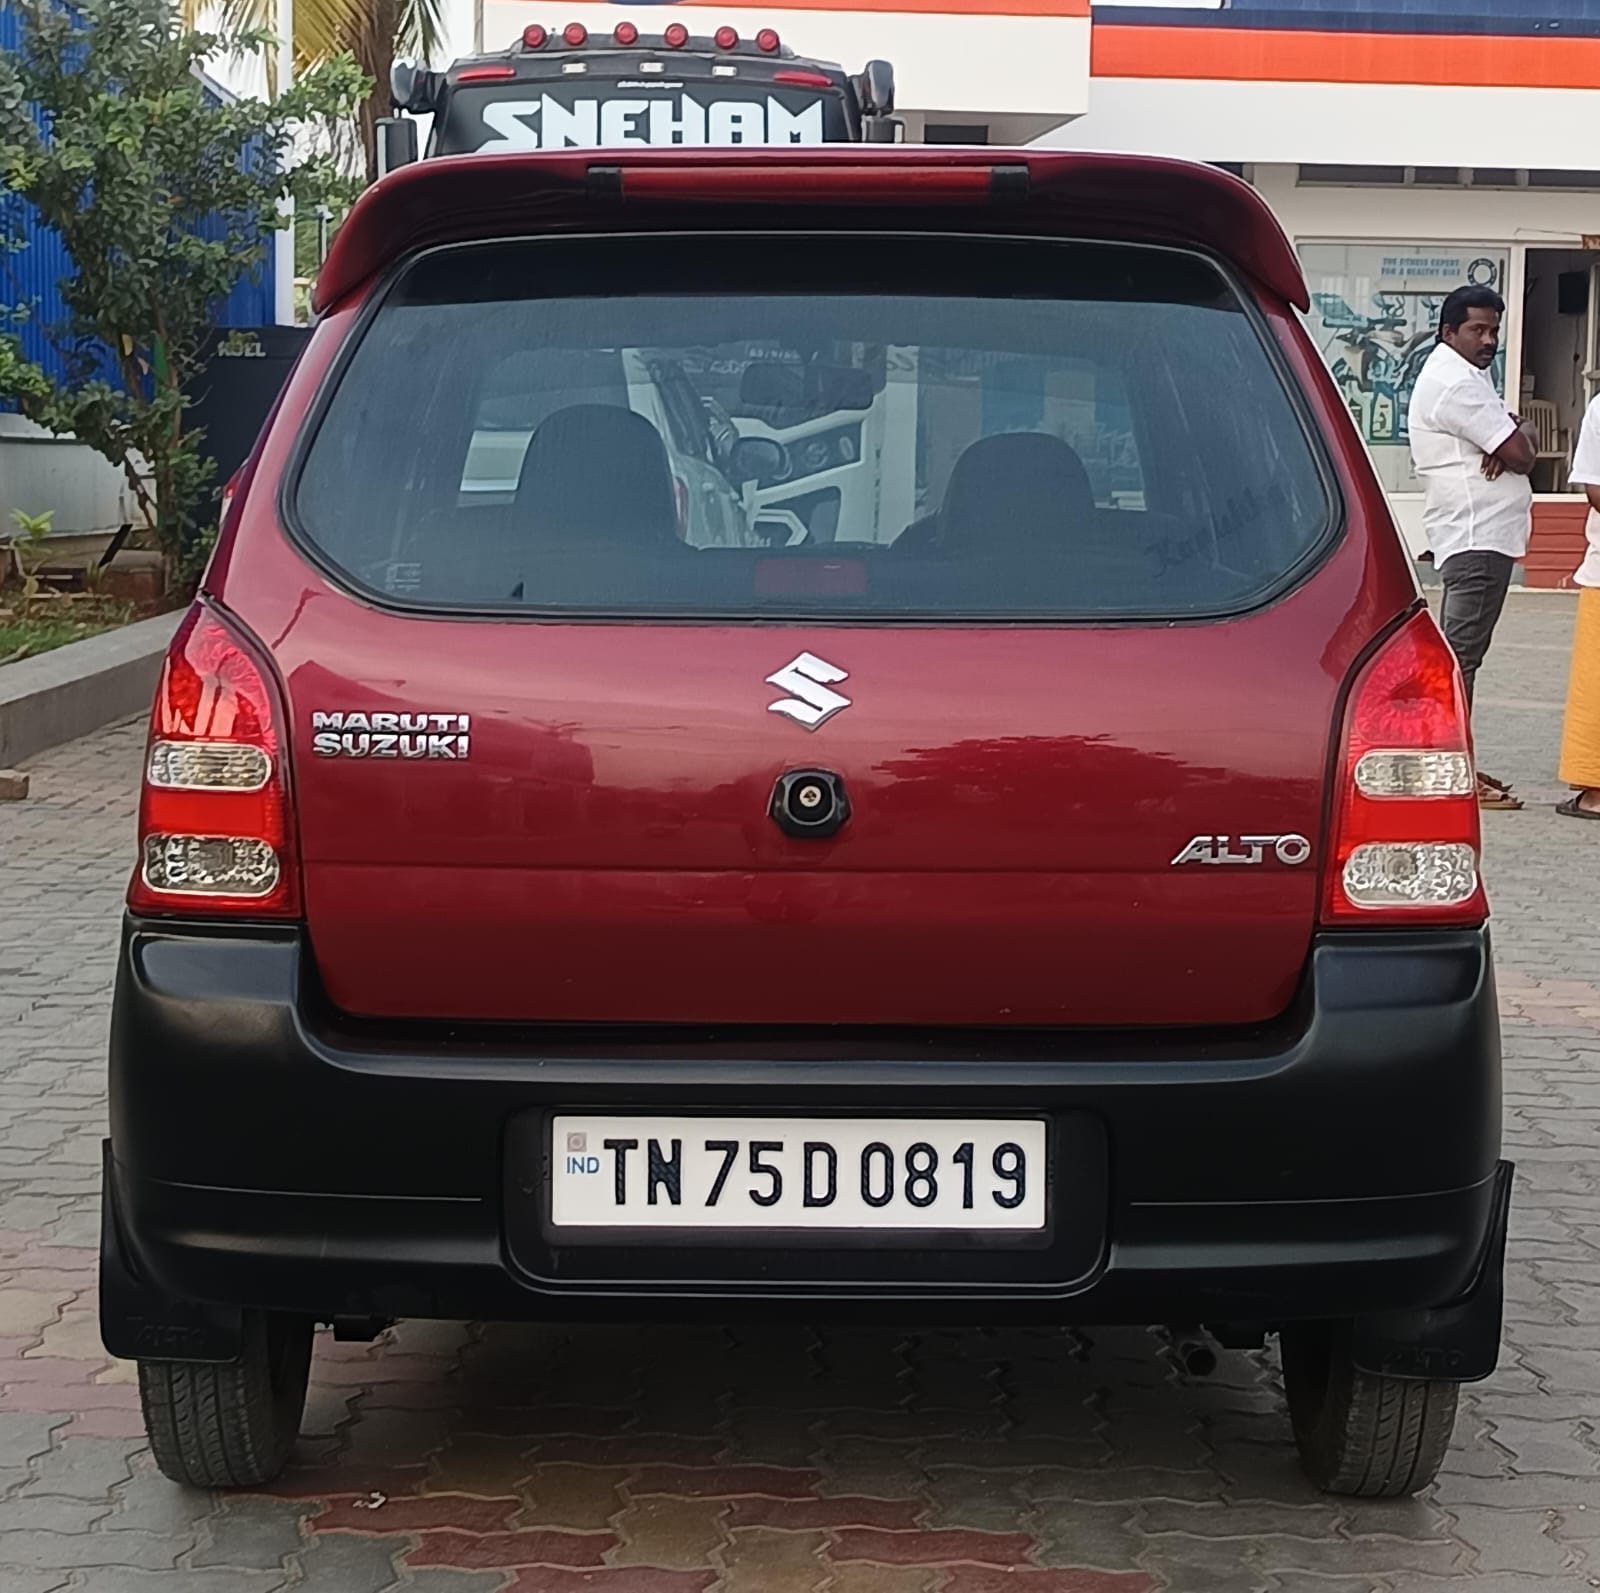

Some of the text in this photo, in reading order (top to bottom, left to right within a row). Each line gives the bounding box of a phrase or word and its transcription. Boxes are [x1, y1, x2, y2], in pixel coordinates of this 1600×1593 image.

[473, 93, 823, 152] SNEHAM
[1381, 267, 1396, 275] FOR
[1406, 268, 1440, 276] HEALTHY
[1430, 258, 1460, 267] EXPERT
[312, 712, 470, 732] MARUTI
[312, 733, 469, 759] SUZUKI
[1171, 834, 1311, 864] ALTO
[566, 1157, 600, 1174] IND
[604, 1139, 1026, 1209] TN 75 D 0819
